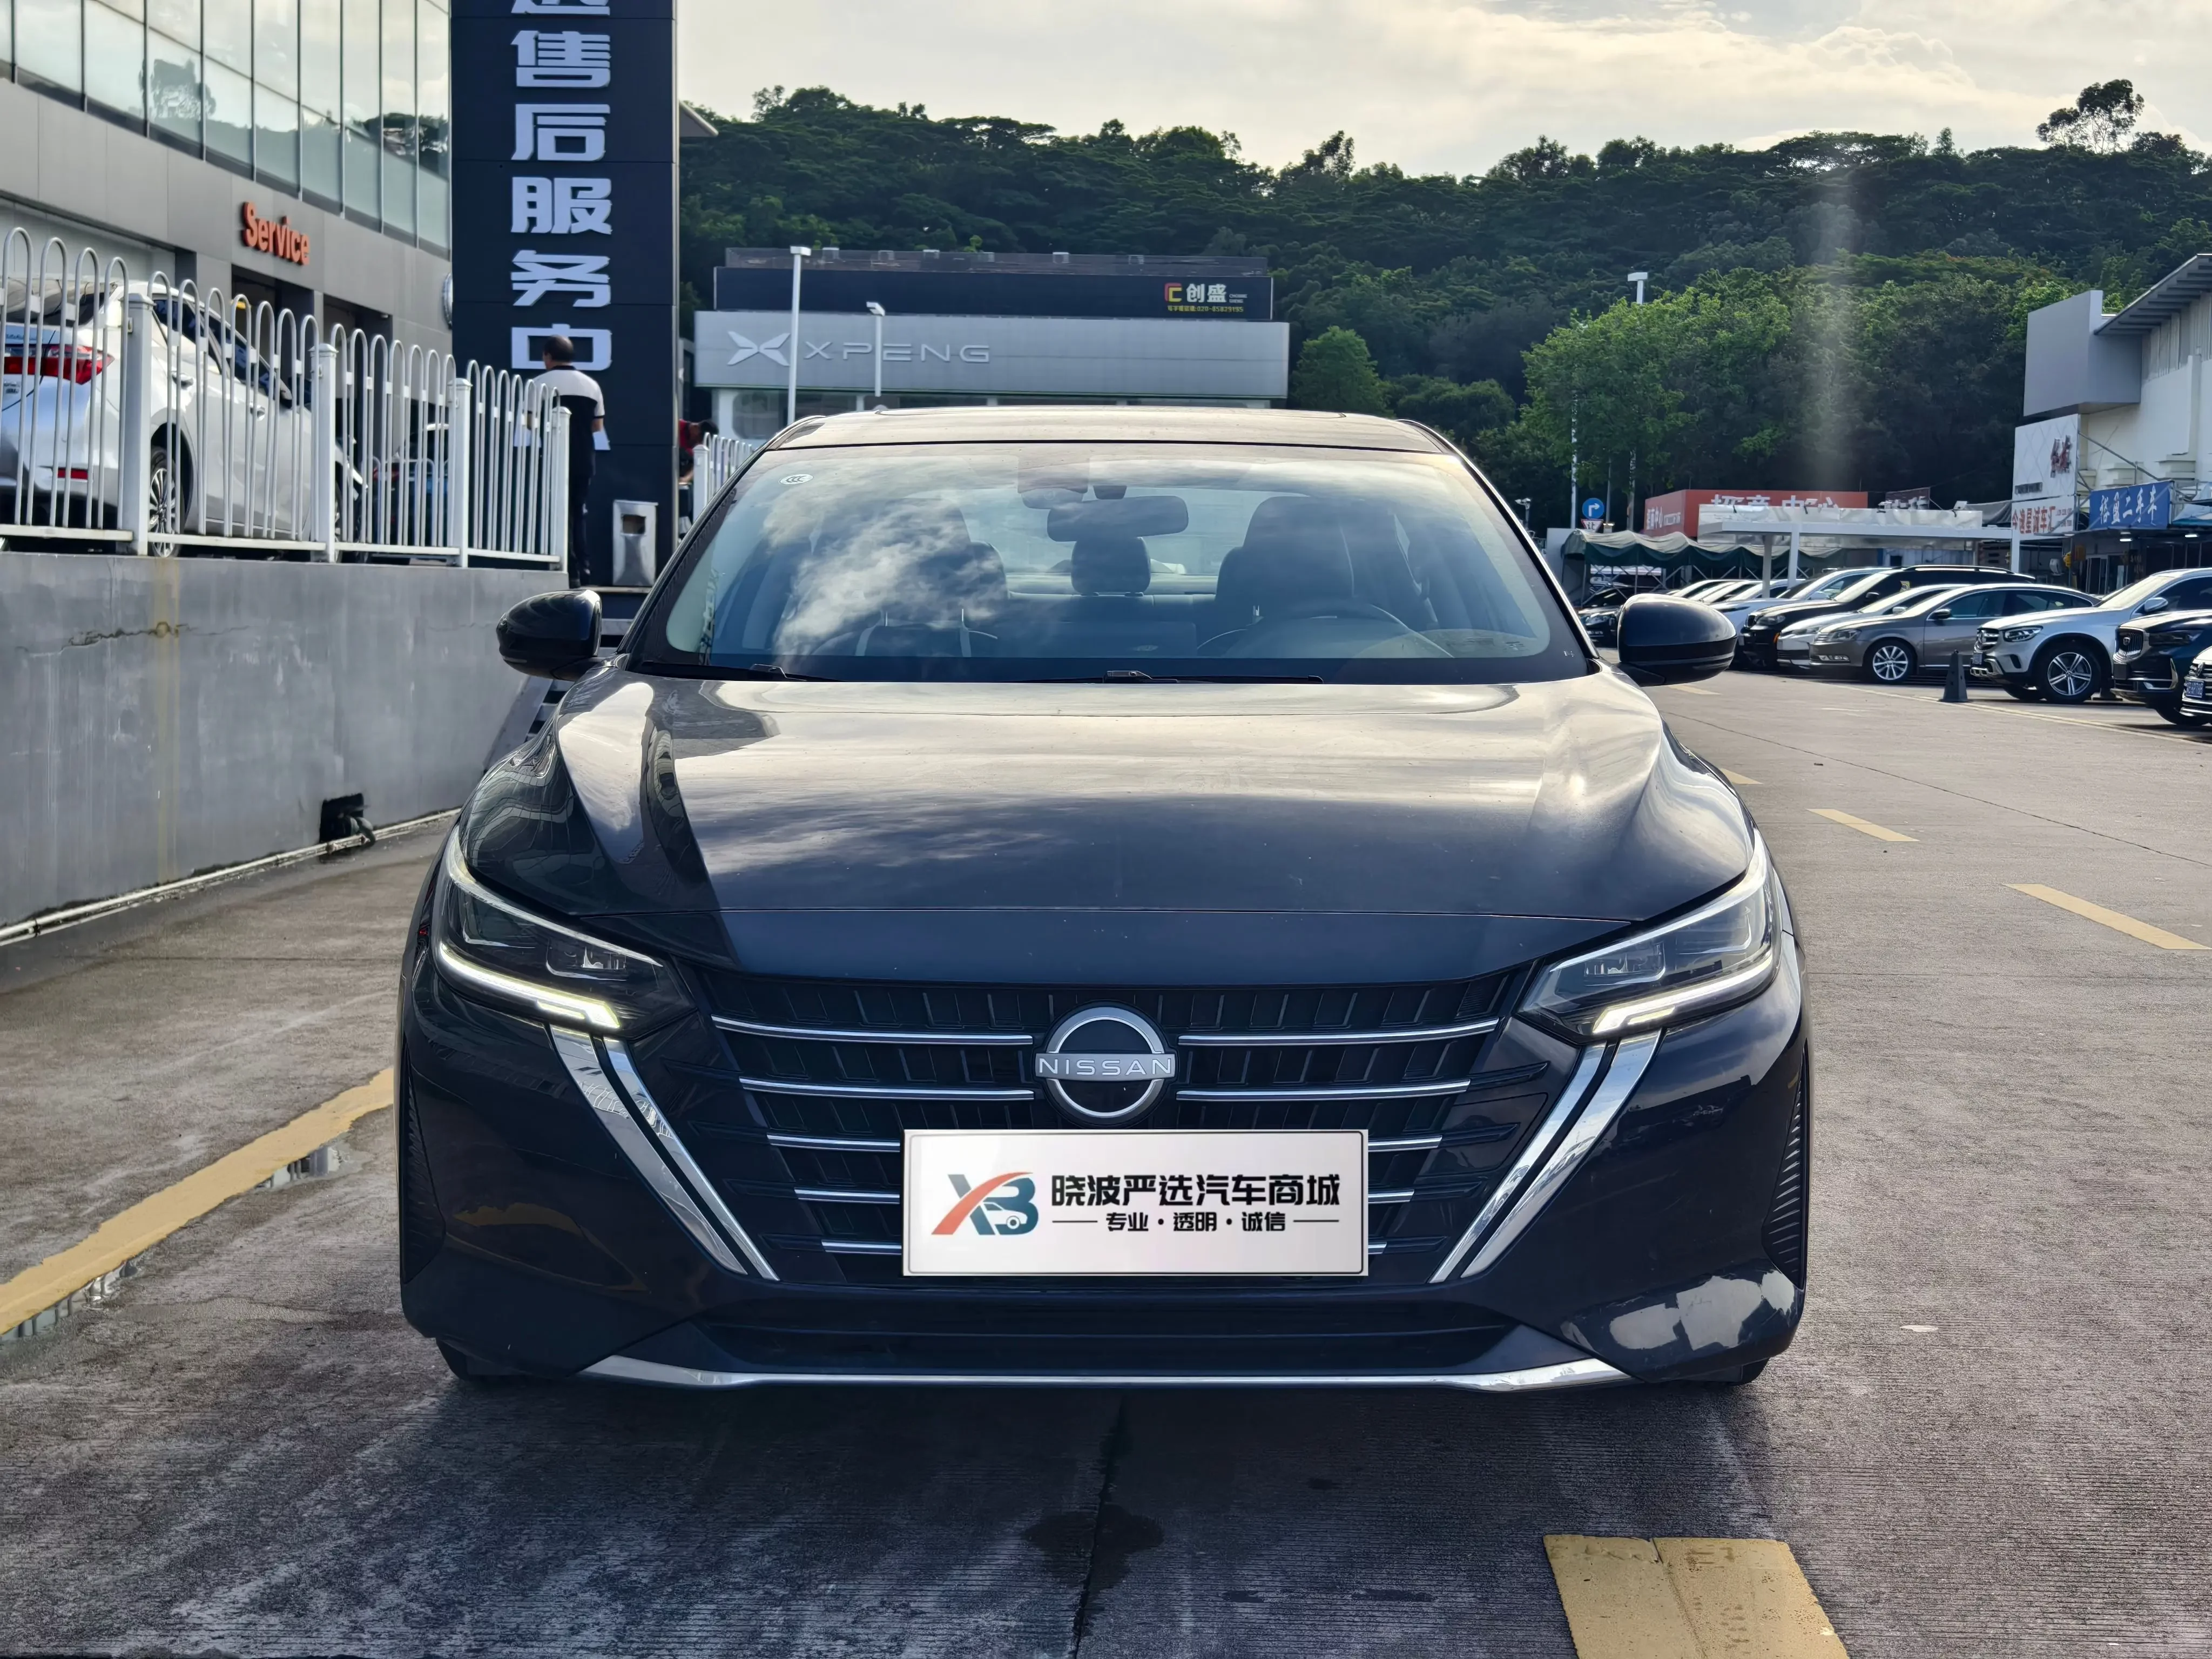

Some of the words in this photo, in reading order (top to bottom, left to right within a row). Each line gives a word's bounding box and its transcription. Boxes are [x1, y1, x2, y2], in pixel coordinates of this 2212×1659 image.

[242, 202, 309, 265] Service
[510, 0, 612, 451] 售后服务中
[1186, 284, 1227, 302] 创盛
[804, 341, 990, 363] XPENG
[1039, 1058, 1171, 1075] NISSAN
[1051, 1174, 1340, 1206] 晓波严选汽车商城
